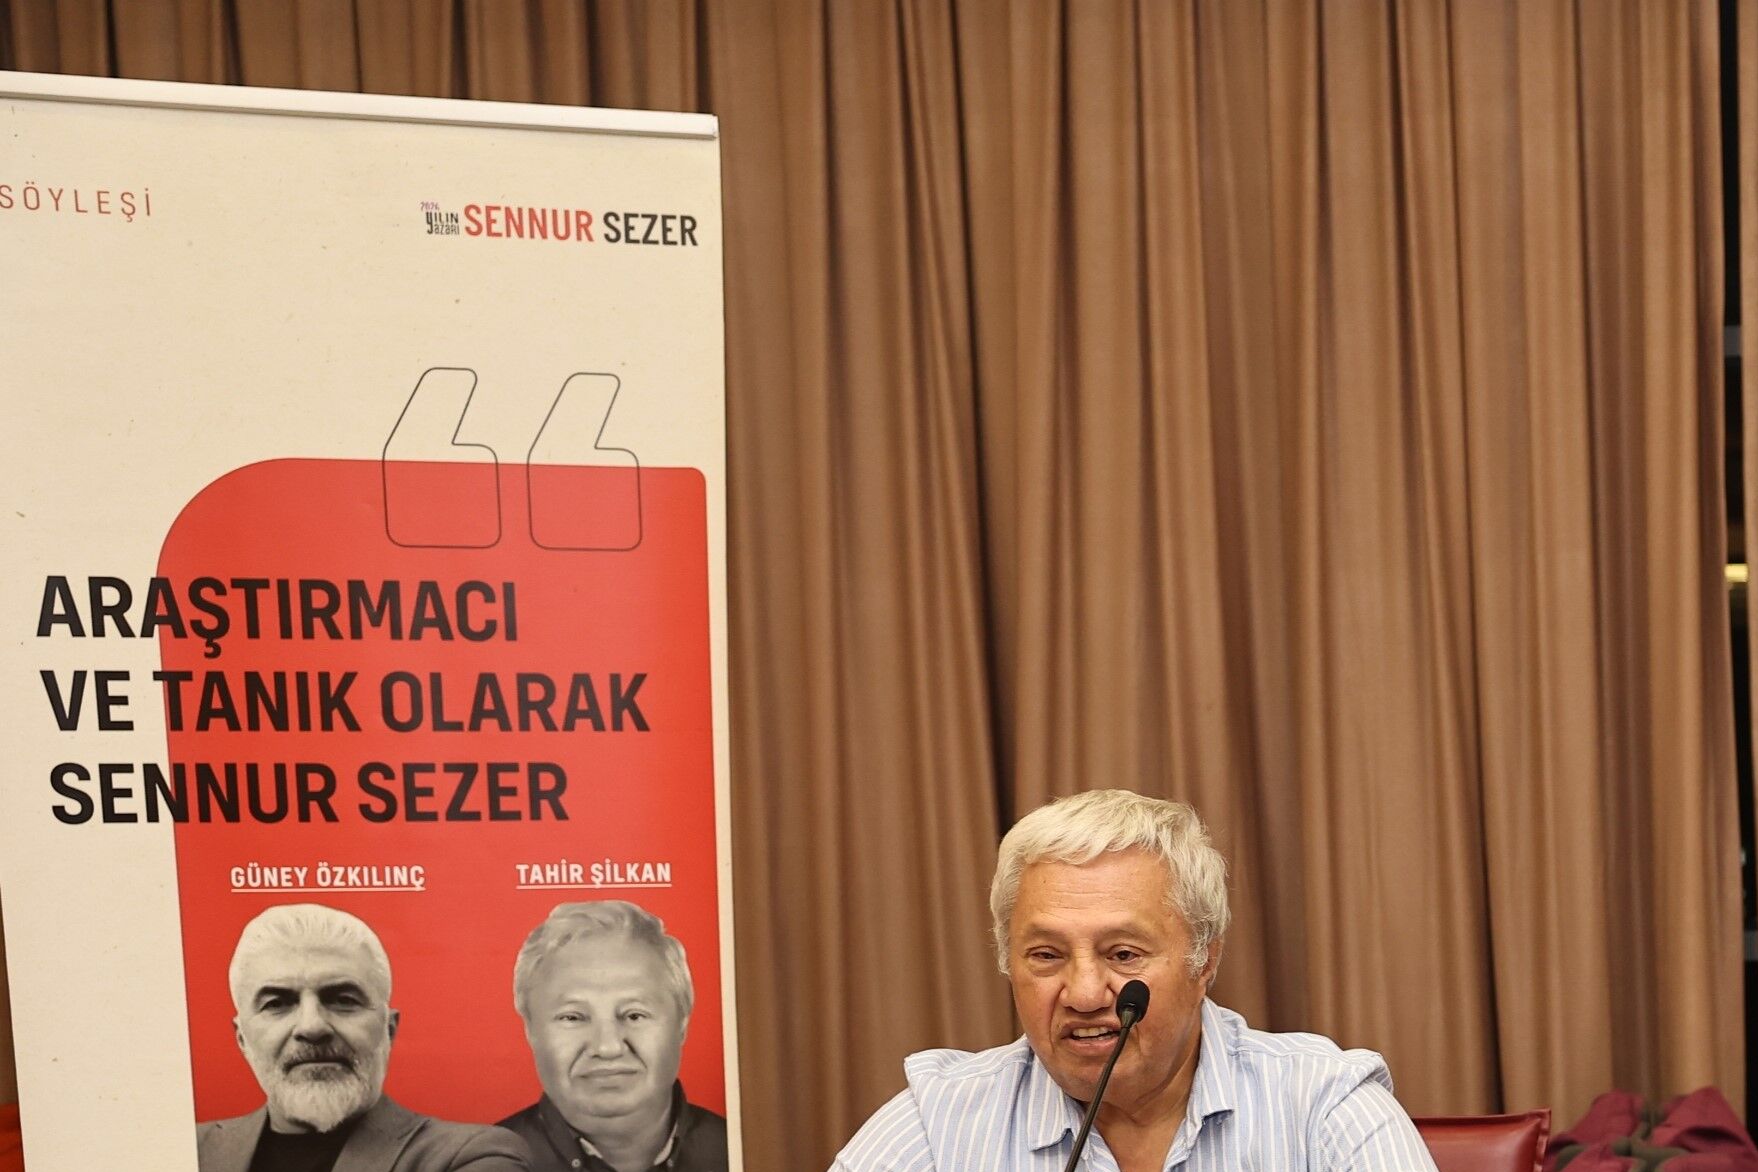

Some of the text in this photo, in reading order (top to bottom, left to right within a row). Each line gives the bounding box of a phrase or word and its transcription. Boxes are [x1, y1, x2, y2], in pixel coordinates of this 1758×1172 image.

[0, 181, 151, 223] SÖYLEŞİ
[464, 204, 699, 246] SENNUR SEZER
[36, 575, 518, 658] ARAŞTIRMACI
[40, 670, 651, 733] VE TANIK OLARAK
[49, 762, 570, 824] SENNUR SEZER
[230, 862, 425, 889] GÜNEY ÖZKILINÇ
[516, 858, 671, 885] TAHİR ŞİLKAN
